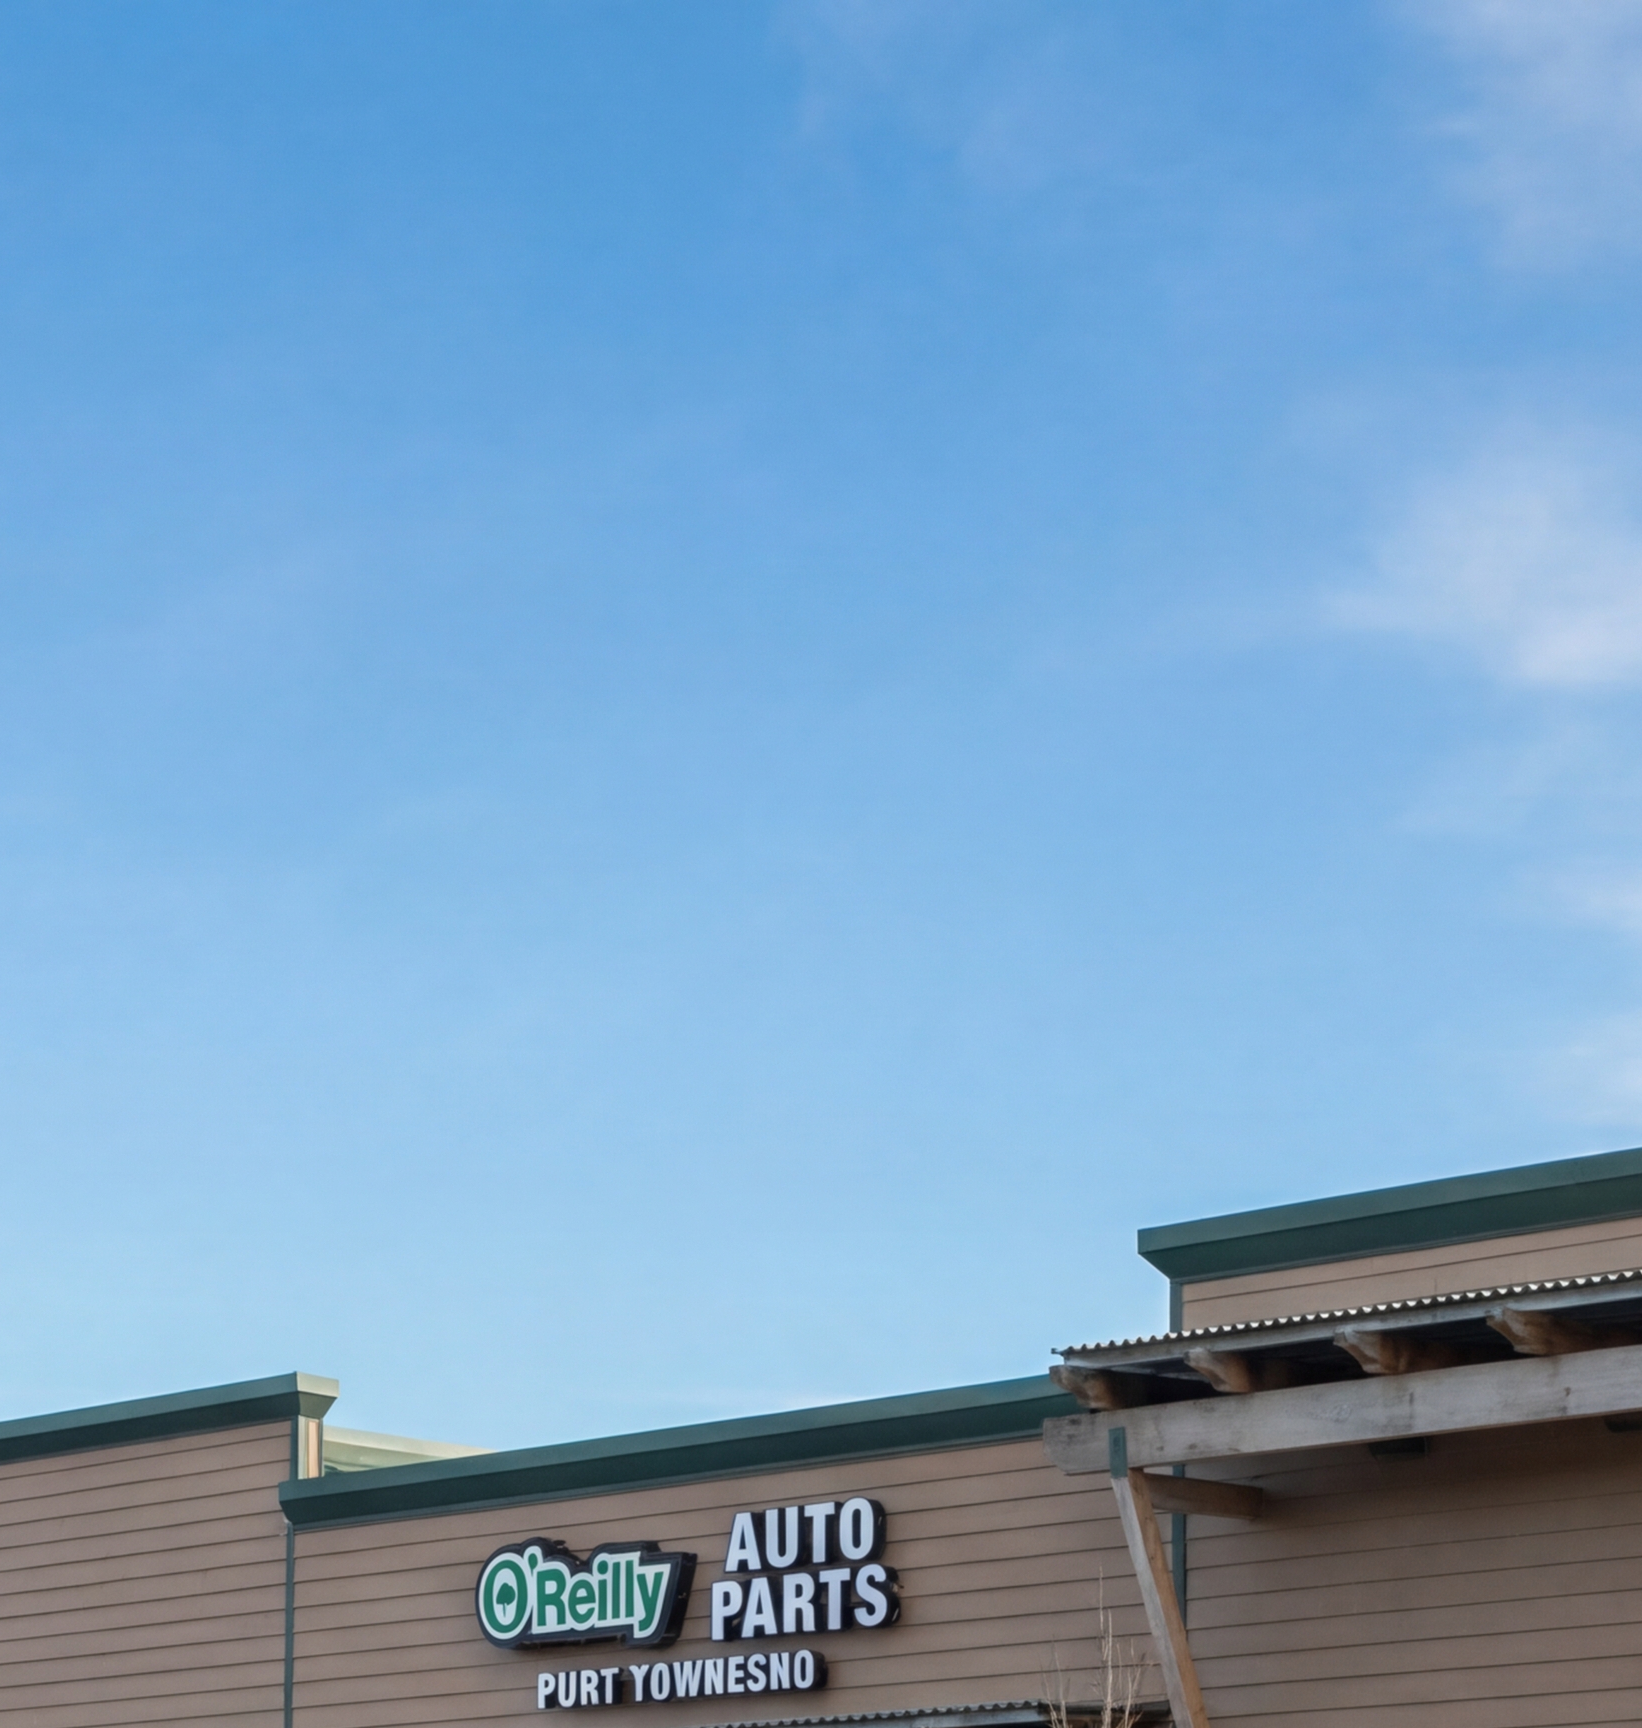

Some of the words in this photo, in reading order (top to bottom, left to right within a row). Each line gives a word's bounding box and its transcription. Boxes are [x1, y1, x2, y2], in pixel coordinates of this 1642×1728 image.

[724, 1497, 875, 1573] AUTO
[480, 1546, 671, 1638] O'Reilly
[711, 1563, 888, 1641] PARTS
[537, 1667, 620, 1709] PURT
